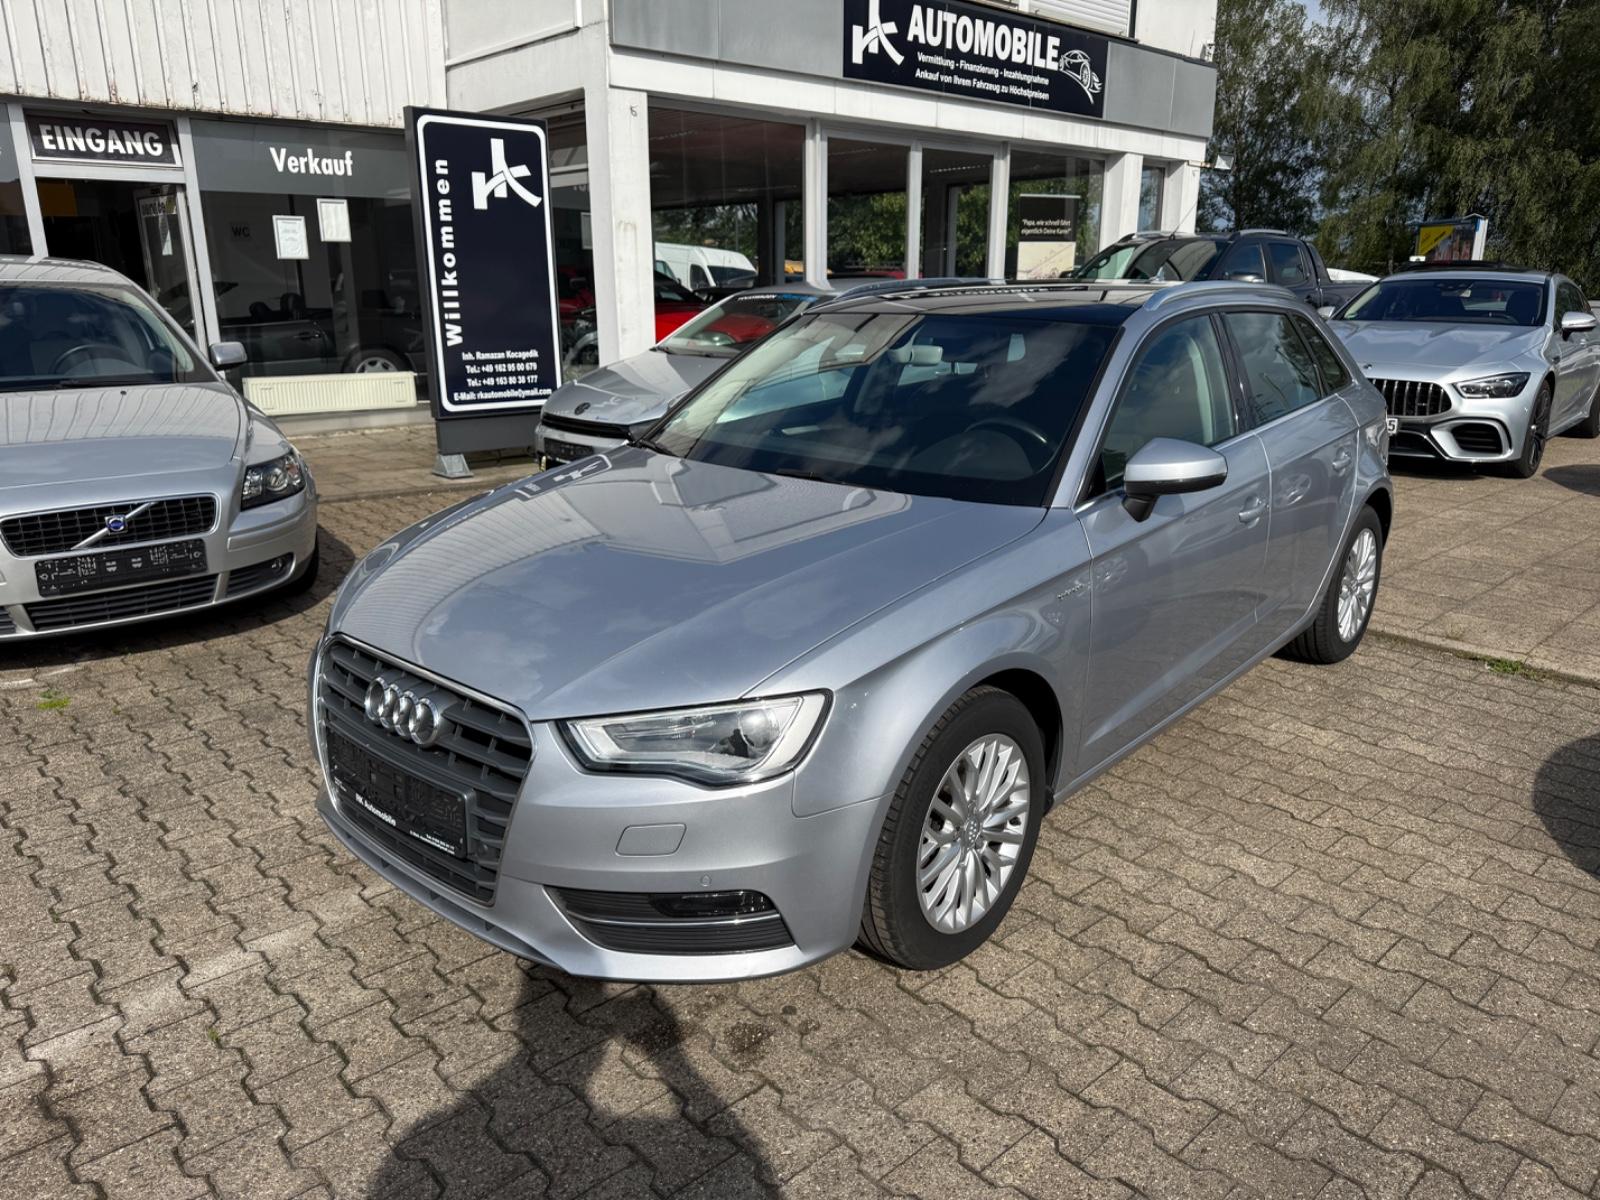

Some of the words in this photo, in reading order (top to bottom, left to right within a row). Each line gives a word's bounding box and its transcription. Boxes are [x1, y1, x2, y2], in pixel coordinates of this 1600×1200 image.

[907, 4, 1060, 71] AUTOMOBILE
[917, 51, 955, 70] Vermittlung
[960, 60, 999, 78] Finanzierung
[915, 68, 939, 81] Ankauf
[940, 74, 952, 83] von
[953, 75, 971, 87] Ihrem
[972, 78, 1000, 94] Fahrzeug
[1001, 85, 1008, 93] zu
[1009, 85, 1049, 100] Höchstpreisen
[39, 124, 163, 157] EINGANG
[270, 147, 353, 176] Verkauf
[435, 159, 463, 347] Willkommen
[462, 351, 475, 360] Inh.
[476, 351, 505, 360] Ramazan
[481, 364, 493, 373] +49
[495, 363, 506, 372] 162
[483, 378, 494, 386] +49
[496, 377, 507, 385] 163
[527, 375, 538, 383] 177
